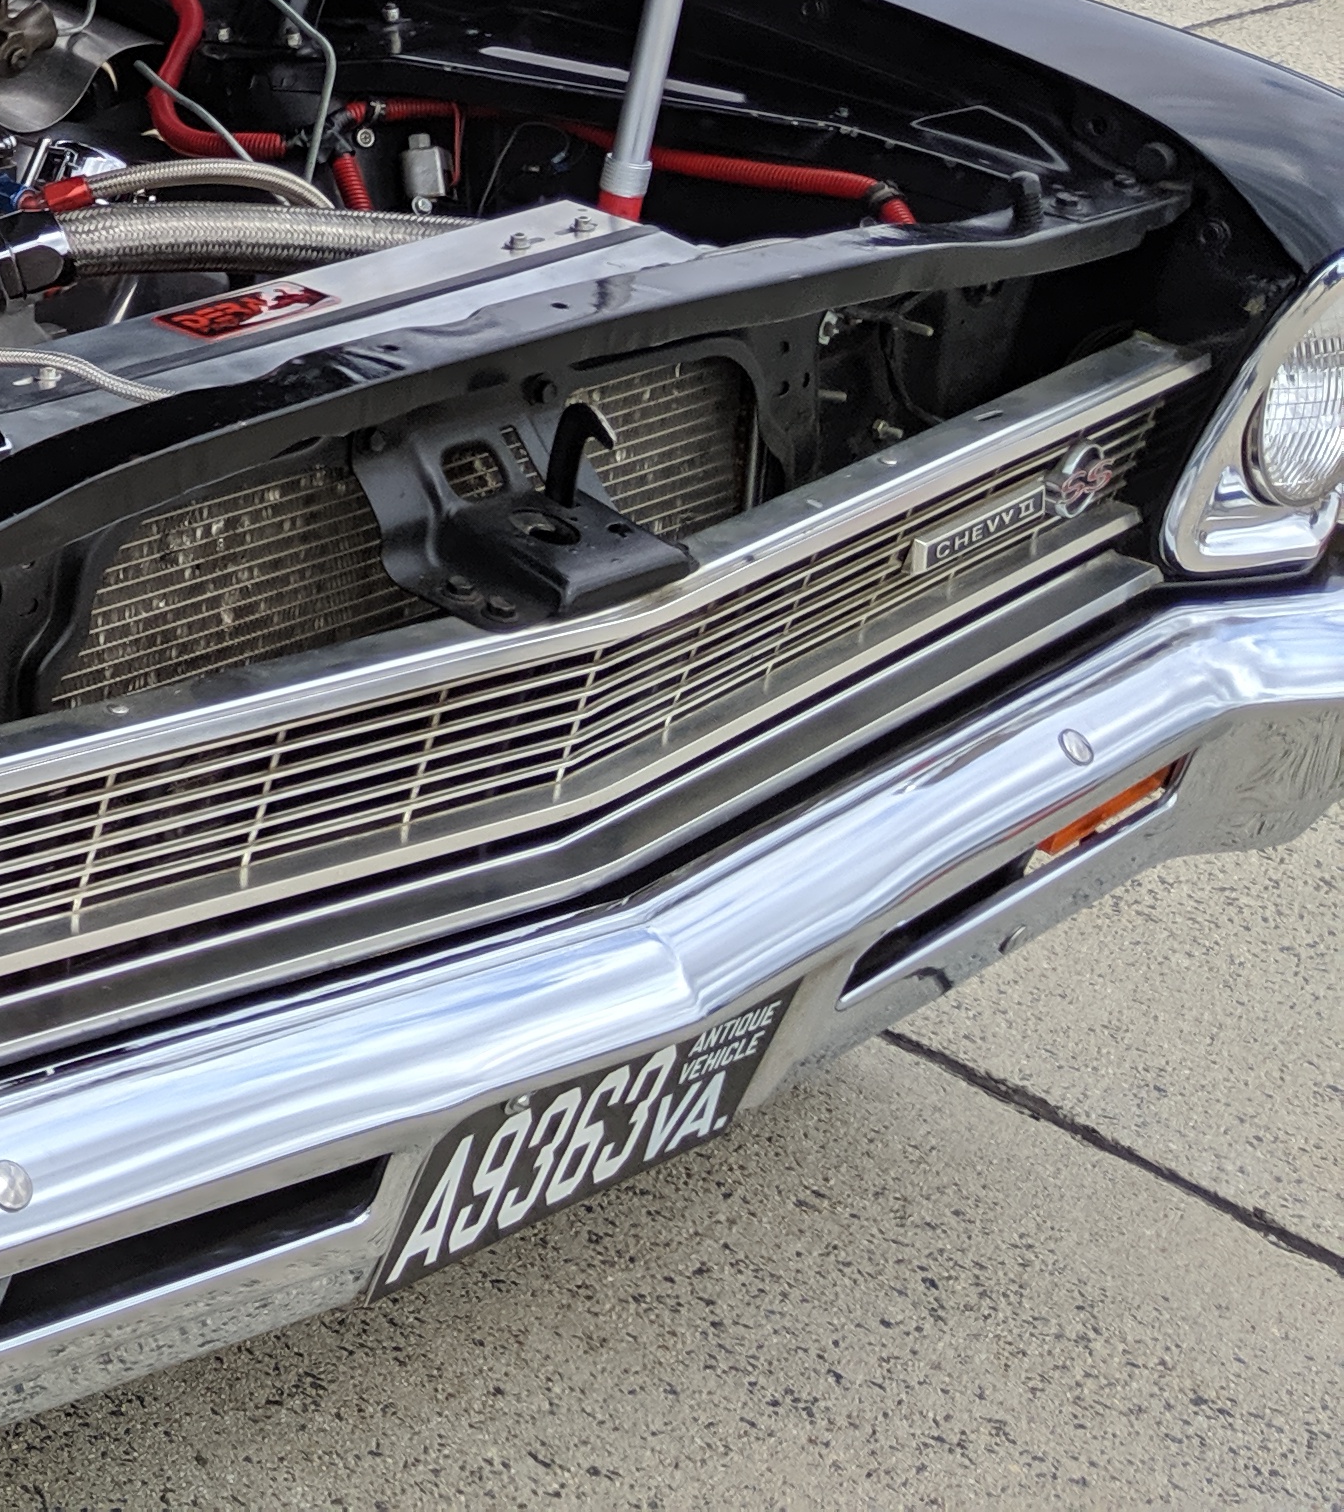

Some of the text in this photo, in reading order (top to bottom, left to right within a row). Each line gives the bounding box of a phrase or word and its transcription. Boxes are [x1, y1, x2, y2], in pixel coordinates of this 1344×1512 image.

[935, 508, 1014, 560] CHEVY
[678, 1030, 767, 1085] VEHICLE
[686, 999, 783, 1059] ANTIQUE
[384, 1044, 678, 1286] A9363
